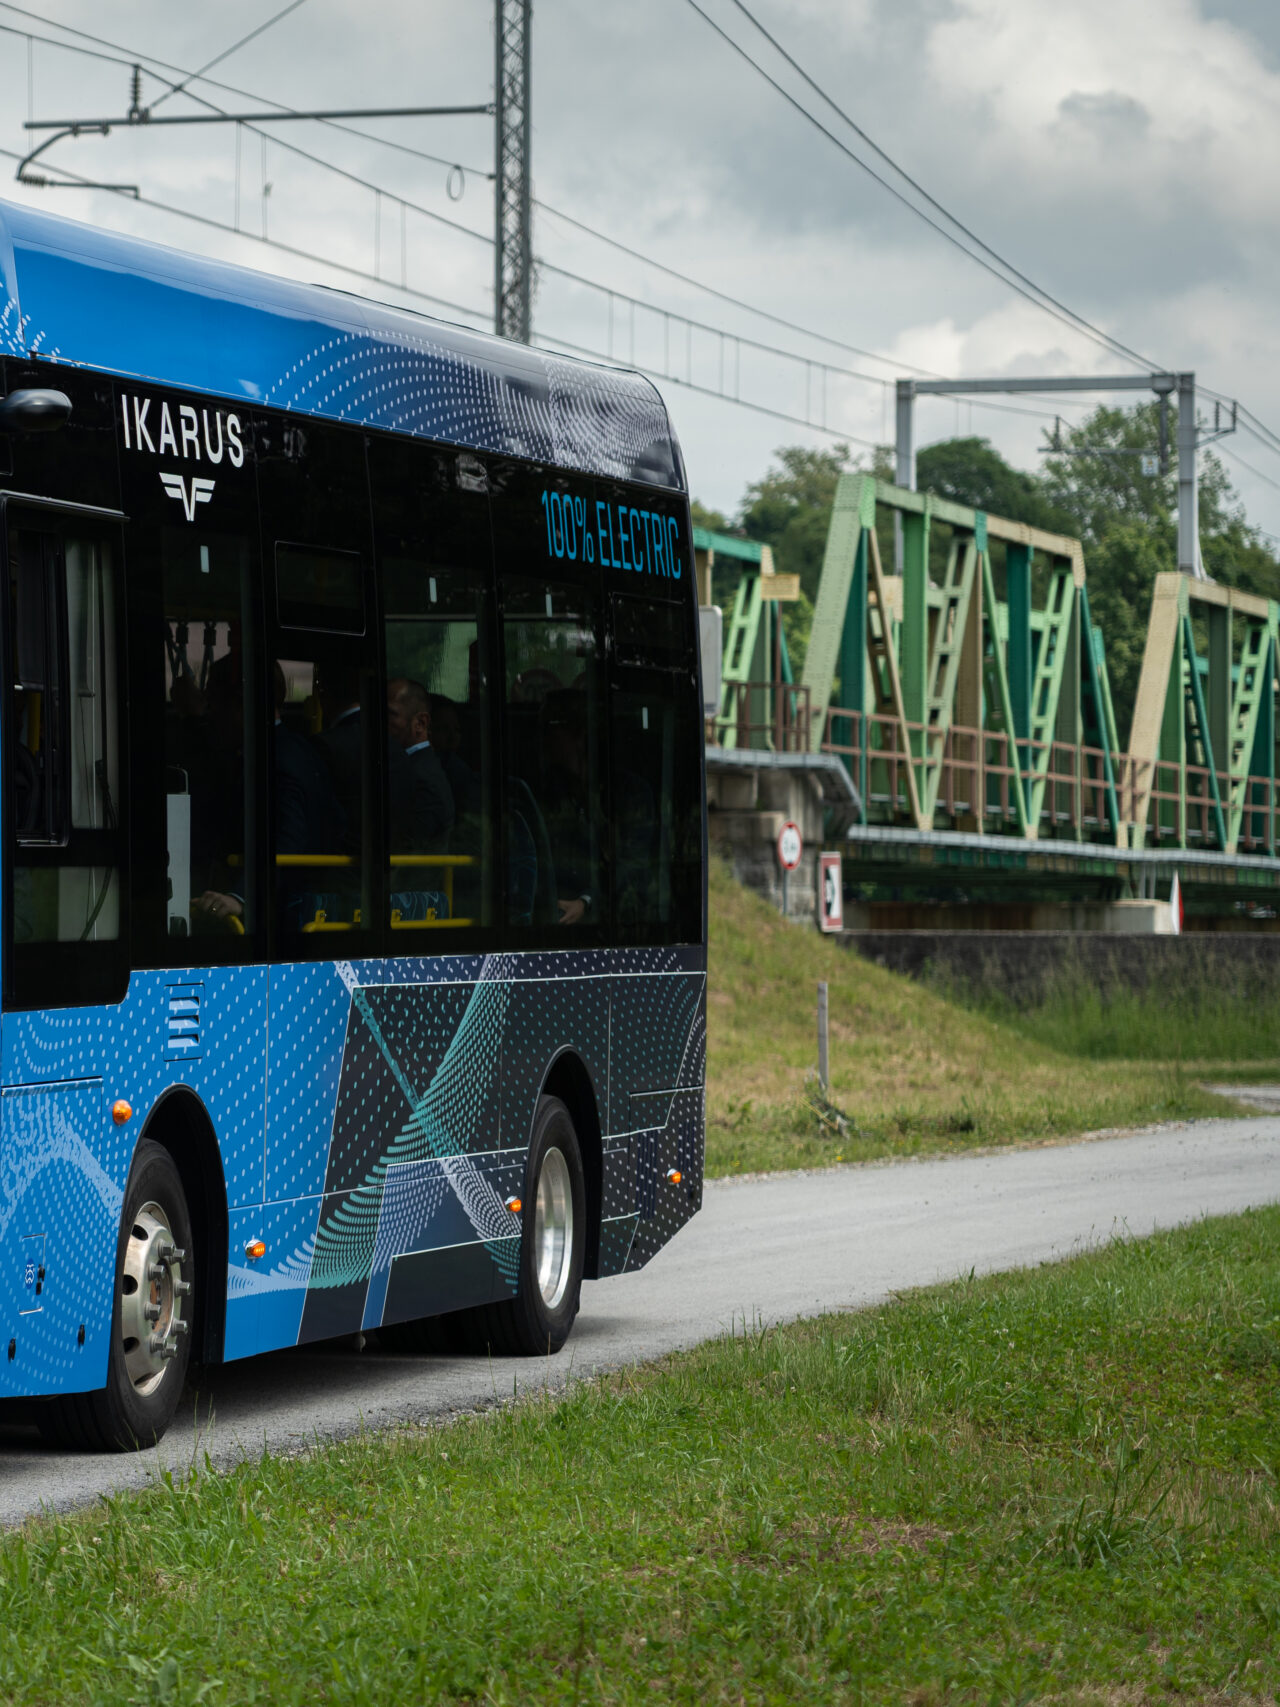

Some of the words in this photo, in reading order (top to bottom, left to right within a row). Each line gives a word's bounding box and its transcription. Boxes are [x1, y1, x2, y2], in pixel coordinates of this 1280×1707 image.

[121, 394, 244, 468] IKARUS
[541, 489, 595, 564] 100%
[596, 501, 682, 579] ELECTRIC
